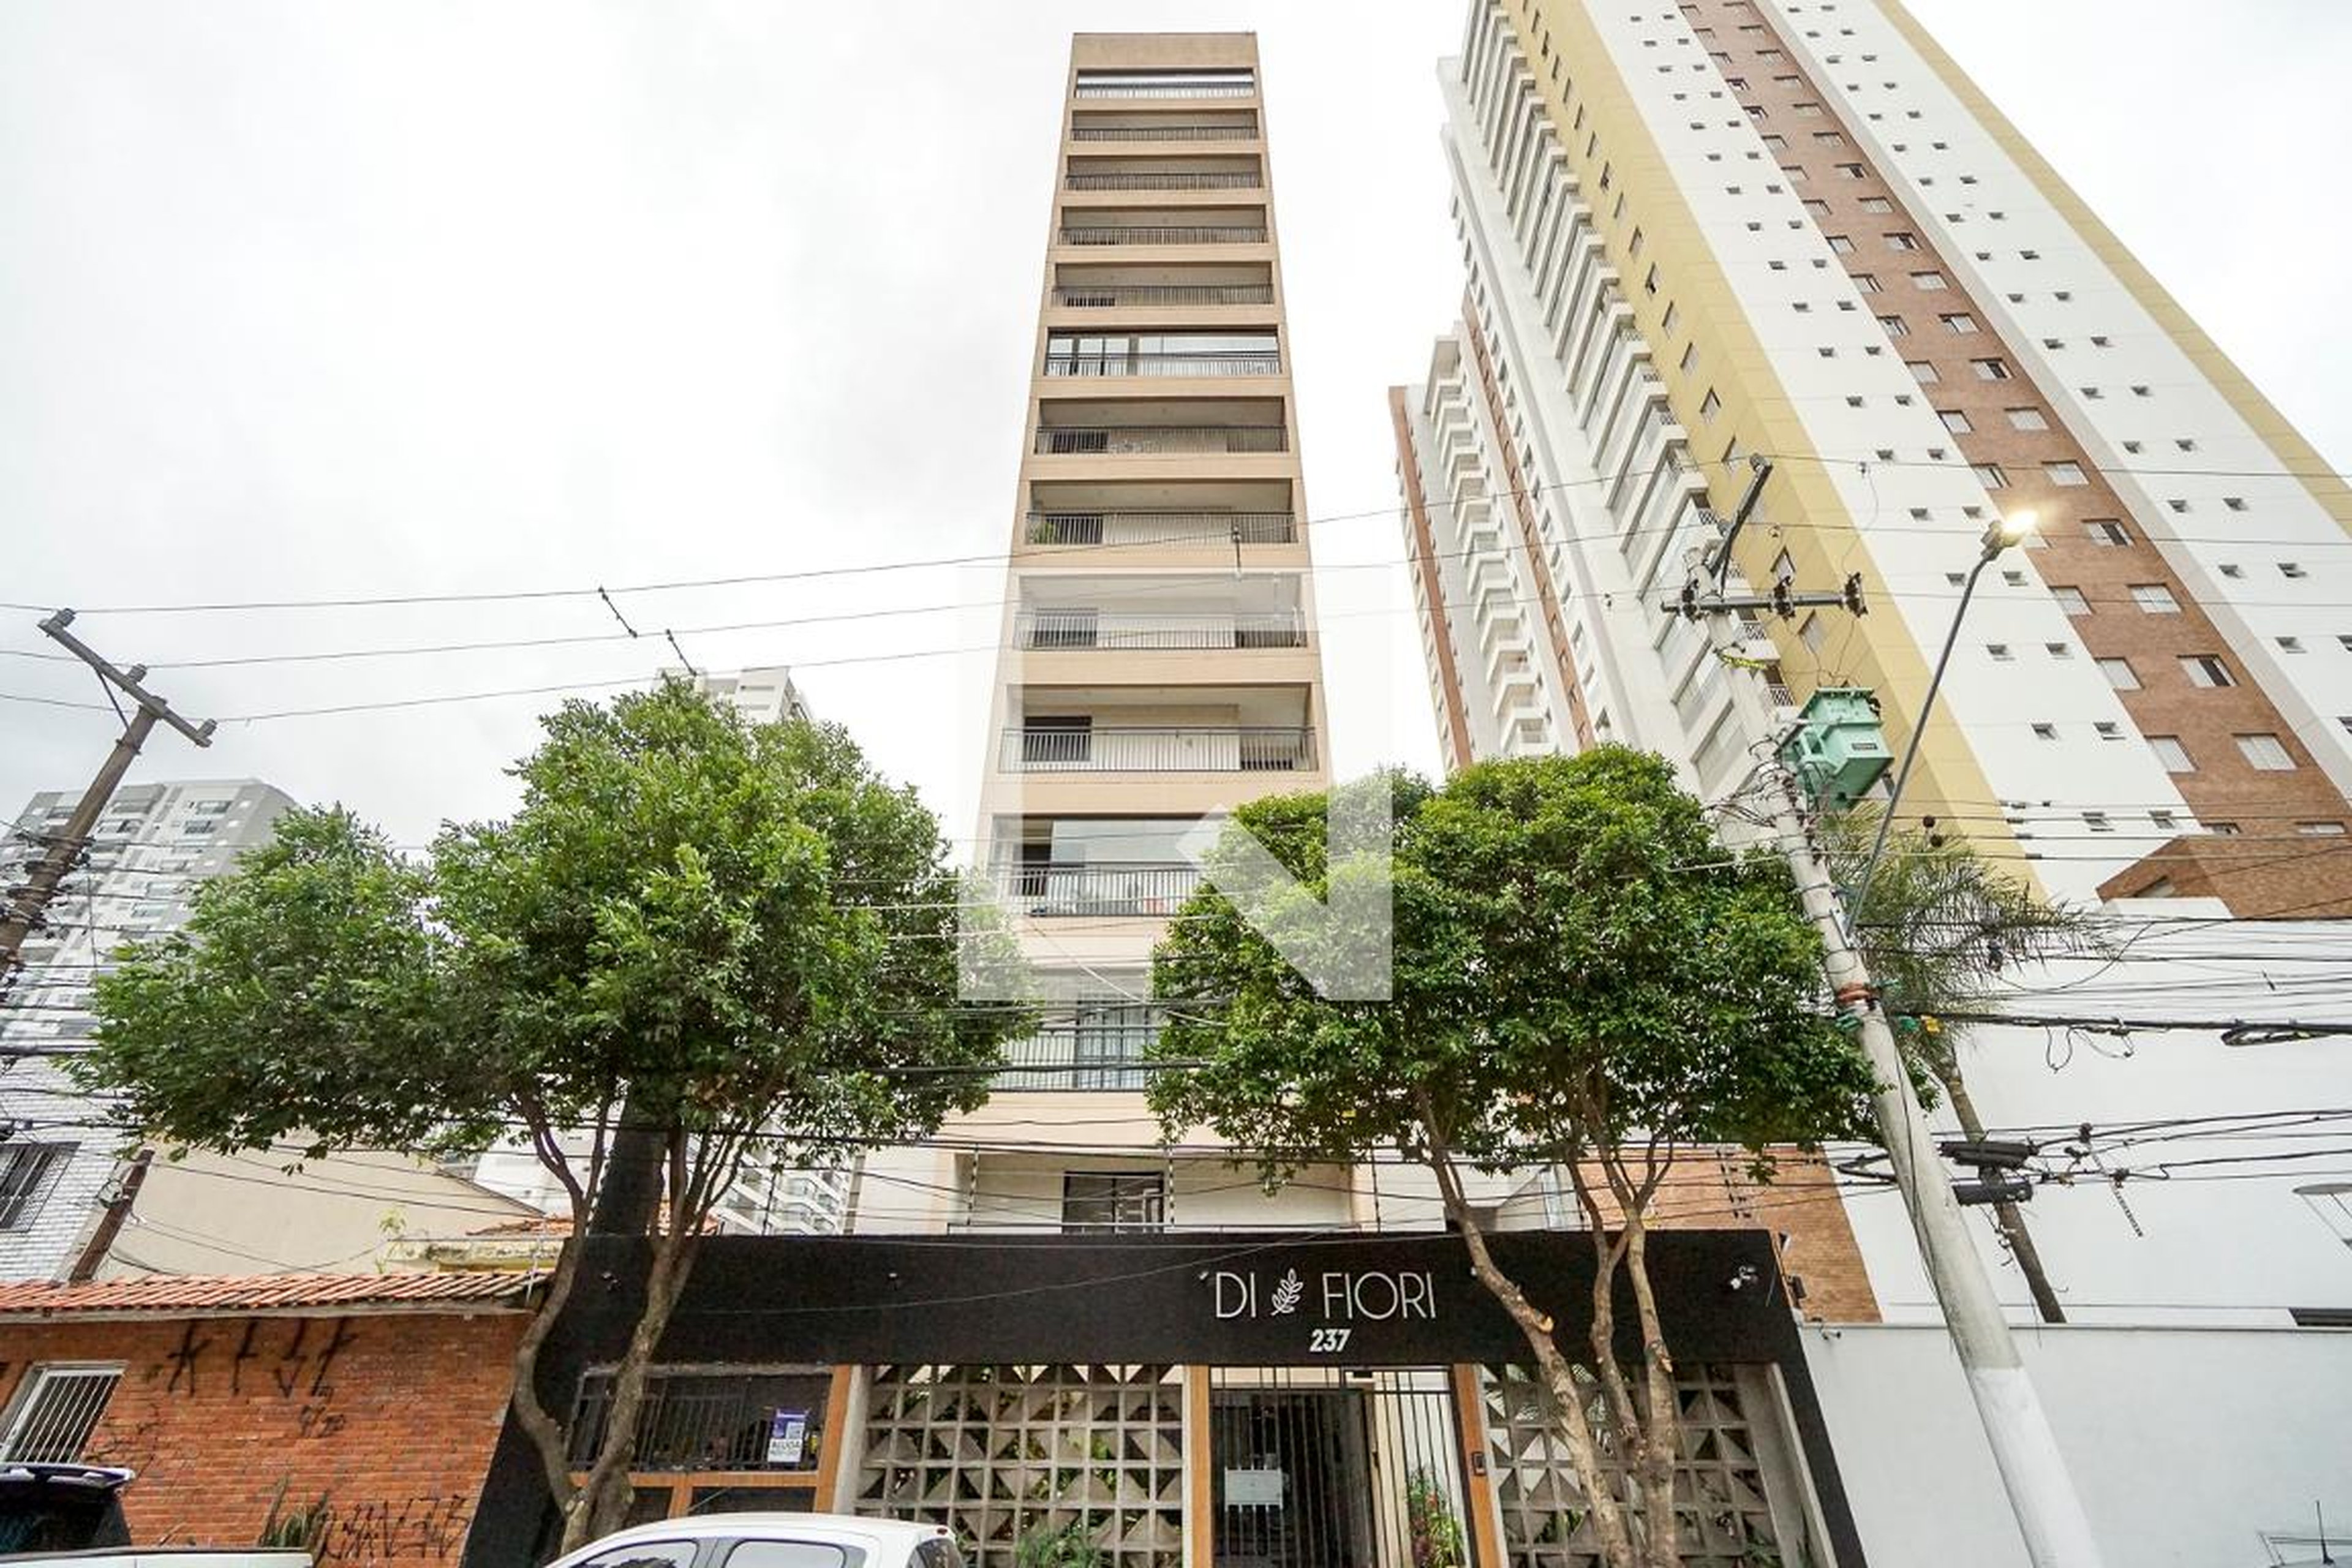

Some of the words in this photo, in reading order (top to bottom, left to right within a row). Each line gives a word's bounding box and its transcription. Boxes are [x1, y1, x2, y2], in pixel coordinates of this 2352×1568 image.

[1215, 1272, 1257, 1319] DI
[1322, 1272, 1436, 1320] FIORI
[1309, 1328, 1352, 1352] 237
